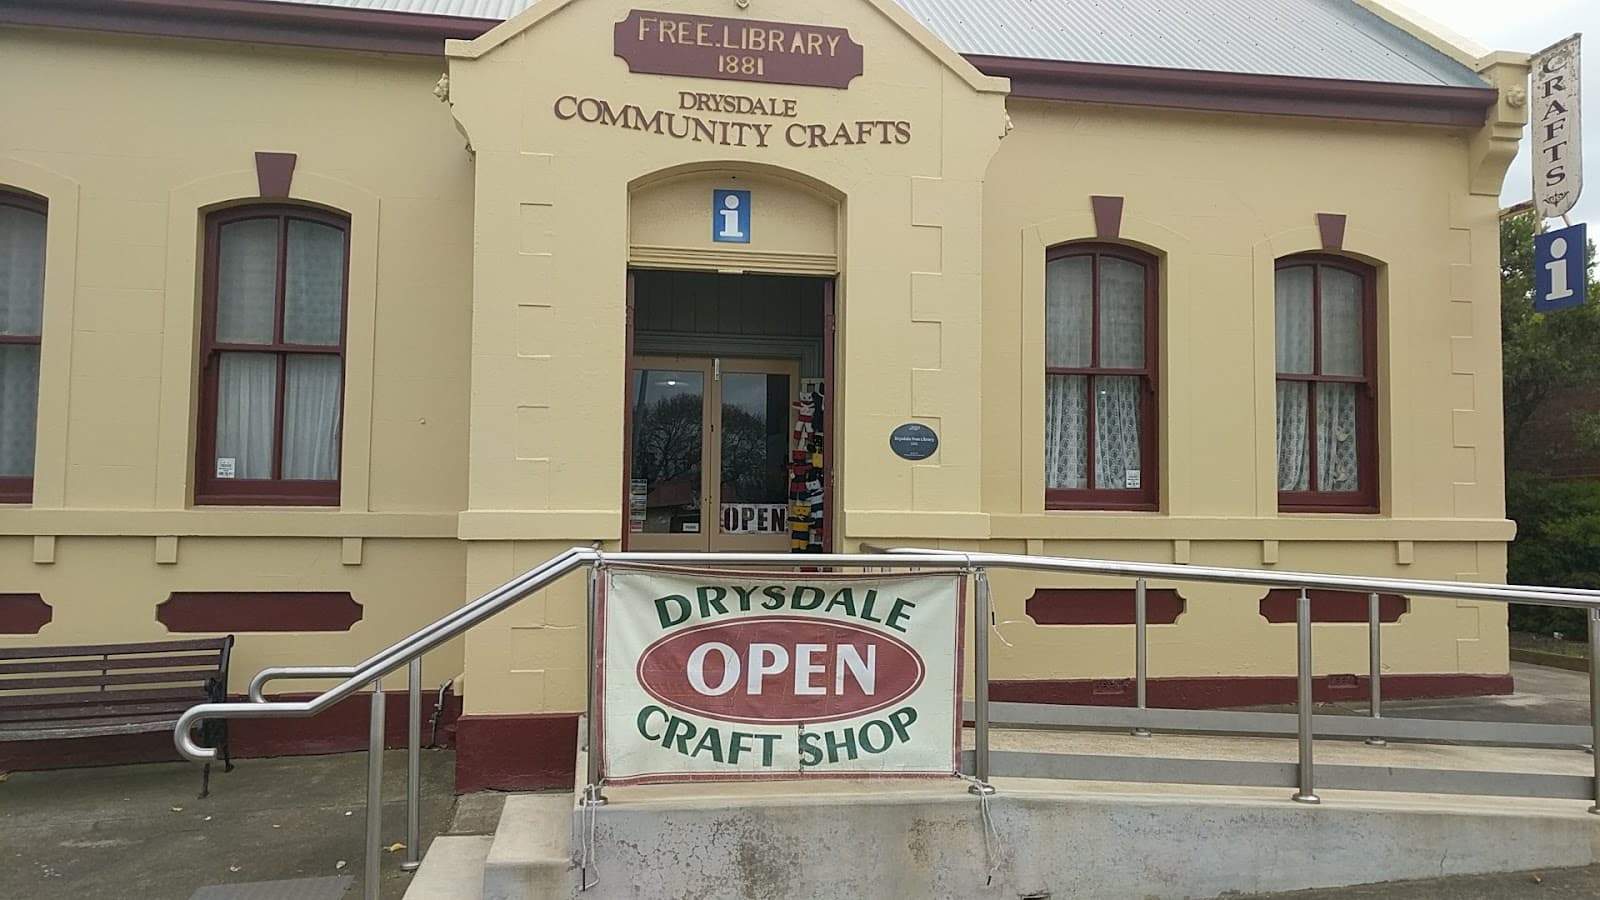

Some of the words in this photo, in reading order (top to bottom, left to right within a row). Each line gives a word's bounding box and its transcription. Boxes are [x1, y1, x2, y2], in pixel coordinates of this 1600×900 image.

[717, 54, 765, 76] 1881
[554, 95, 772, 148] COMMUNITY
[785, 120, 912, 148] CRAFTS
[678, 91, 798, 118] DRYSDALE
[1541, 54, 1568, 187] CRAFTS
[723, 507, 786, 532] OPEN
[654, 585, 916, 633] DRYSDALE
[687, 642, 876, 696] OPEN
[636, 705, 782, 767] CRAFT
[799, 706, 918, 767] SHOP
